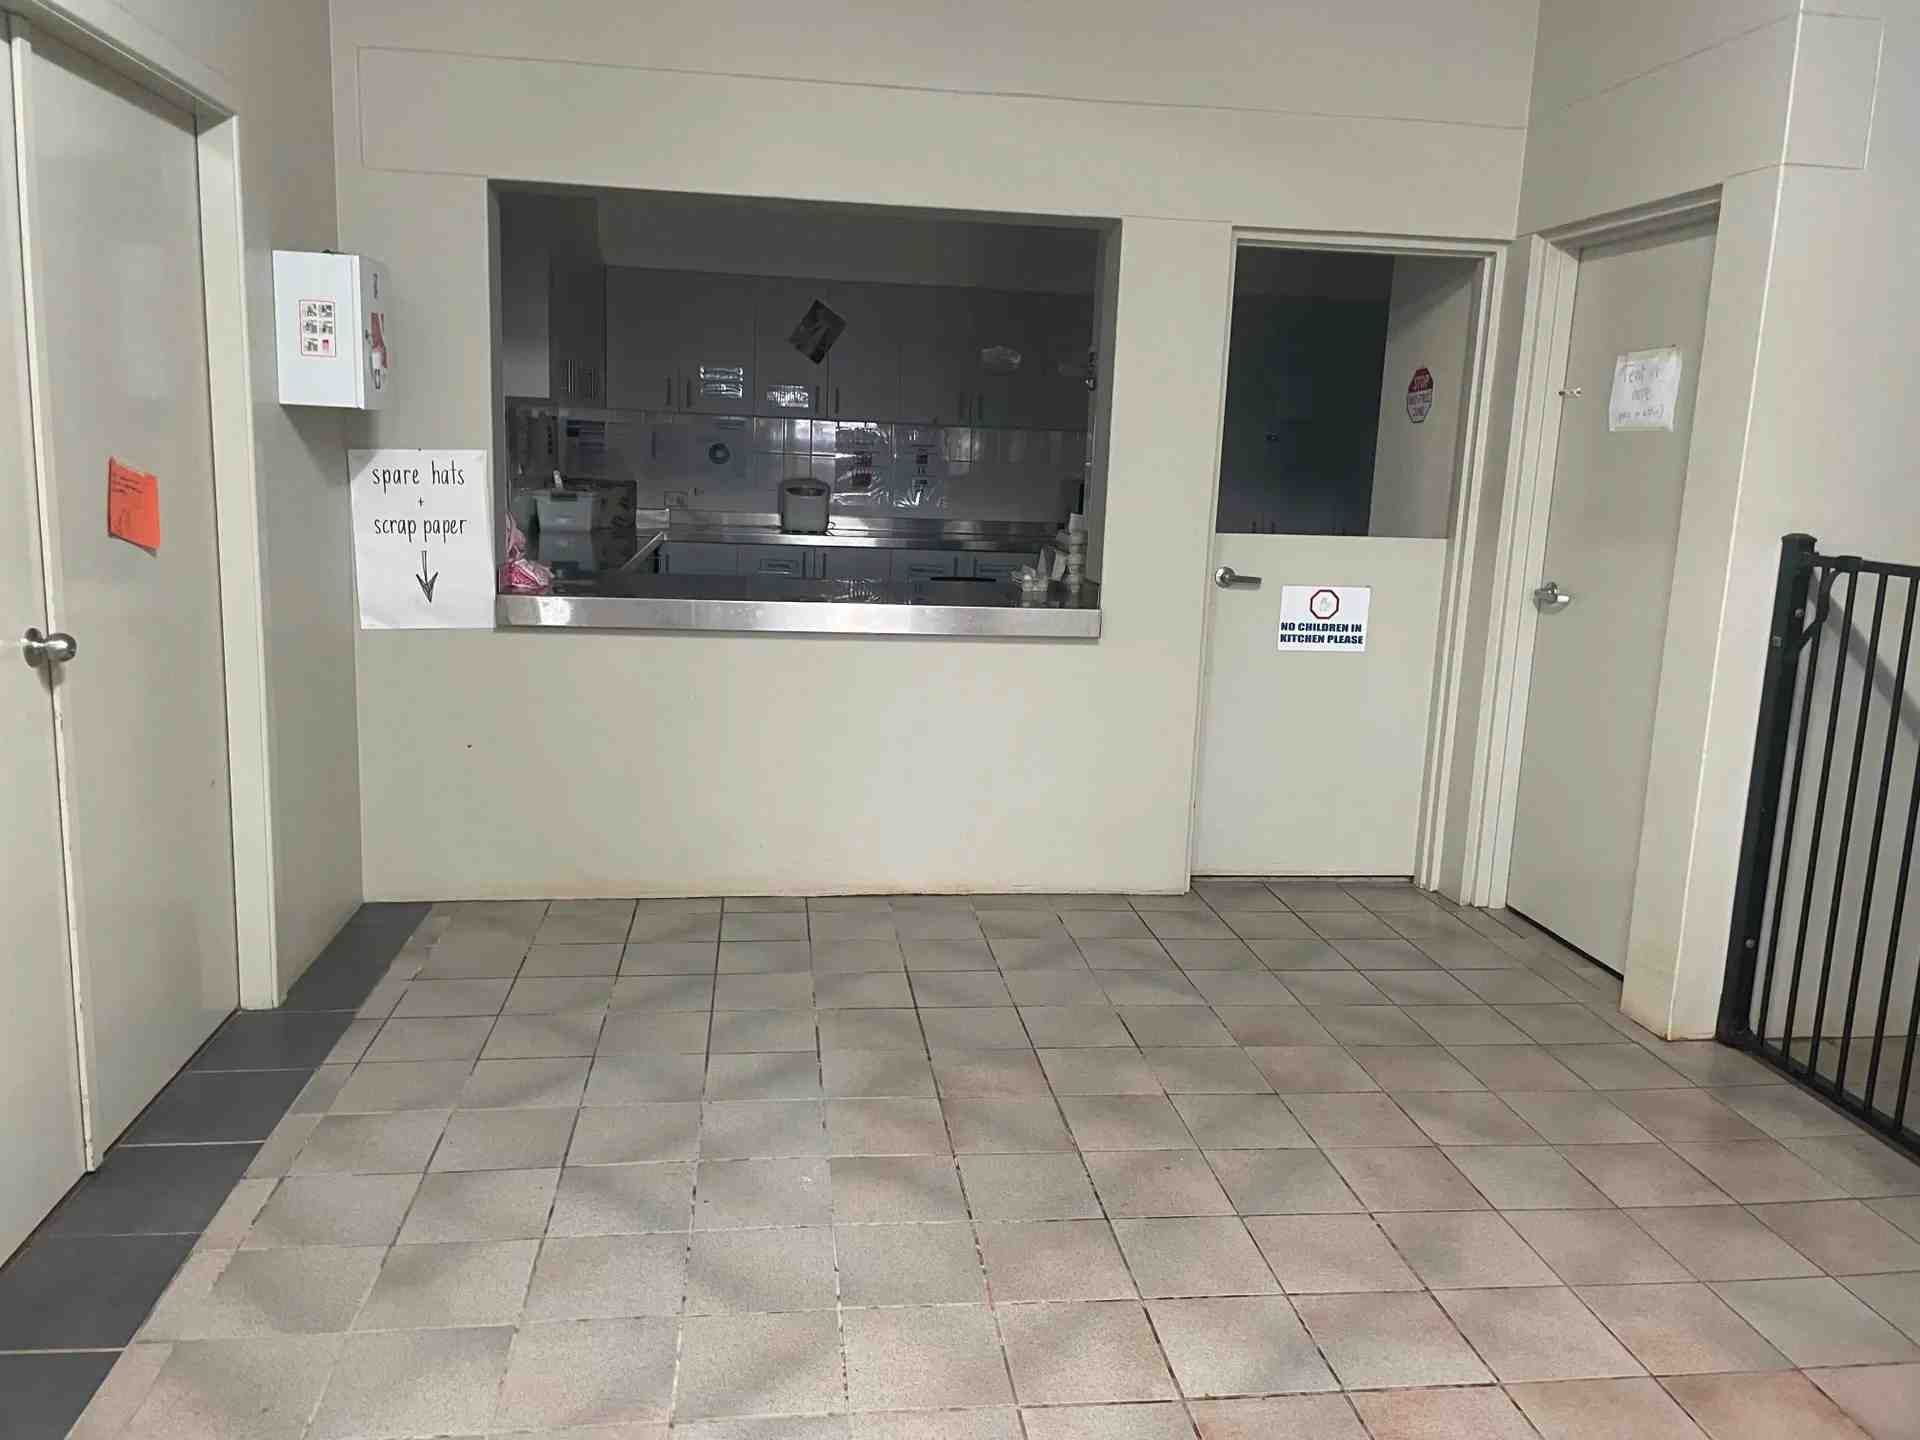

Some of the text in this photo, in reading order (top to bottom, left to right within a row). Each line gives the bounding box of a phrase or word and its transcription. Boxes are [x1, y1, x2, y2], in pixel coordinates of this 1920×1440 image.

[372, 460, 465, 495] spare hats
[374, 519, 467, 544] scrap paper
[1280, 622, 1362, 632] NO CHILDREN IN
[1280, 633, 1364, 644] KITCHEN PLEASE
